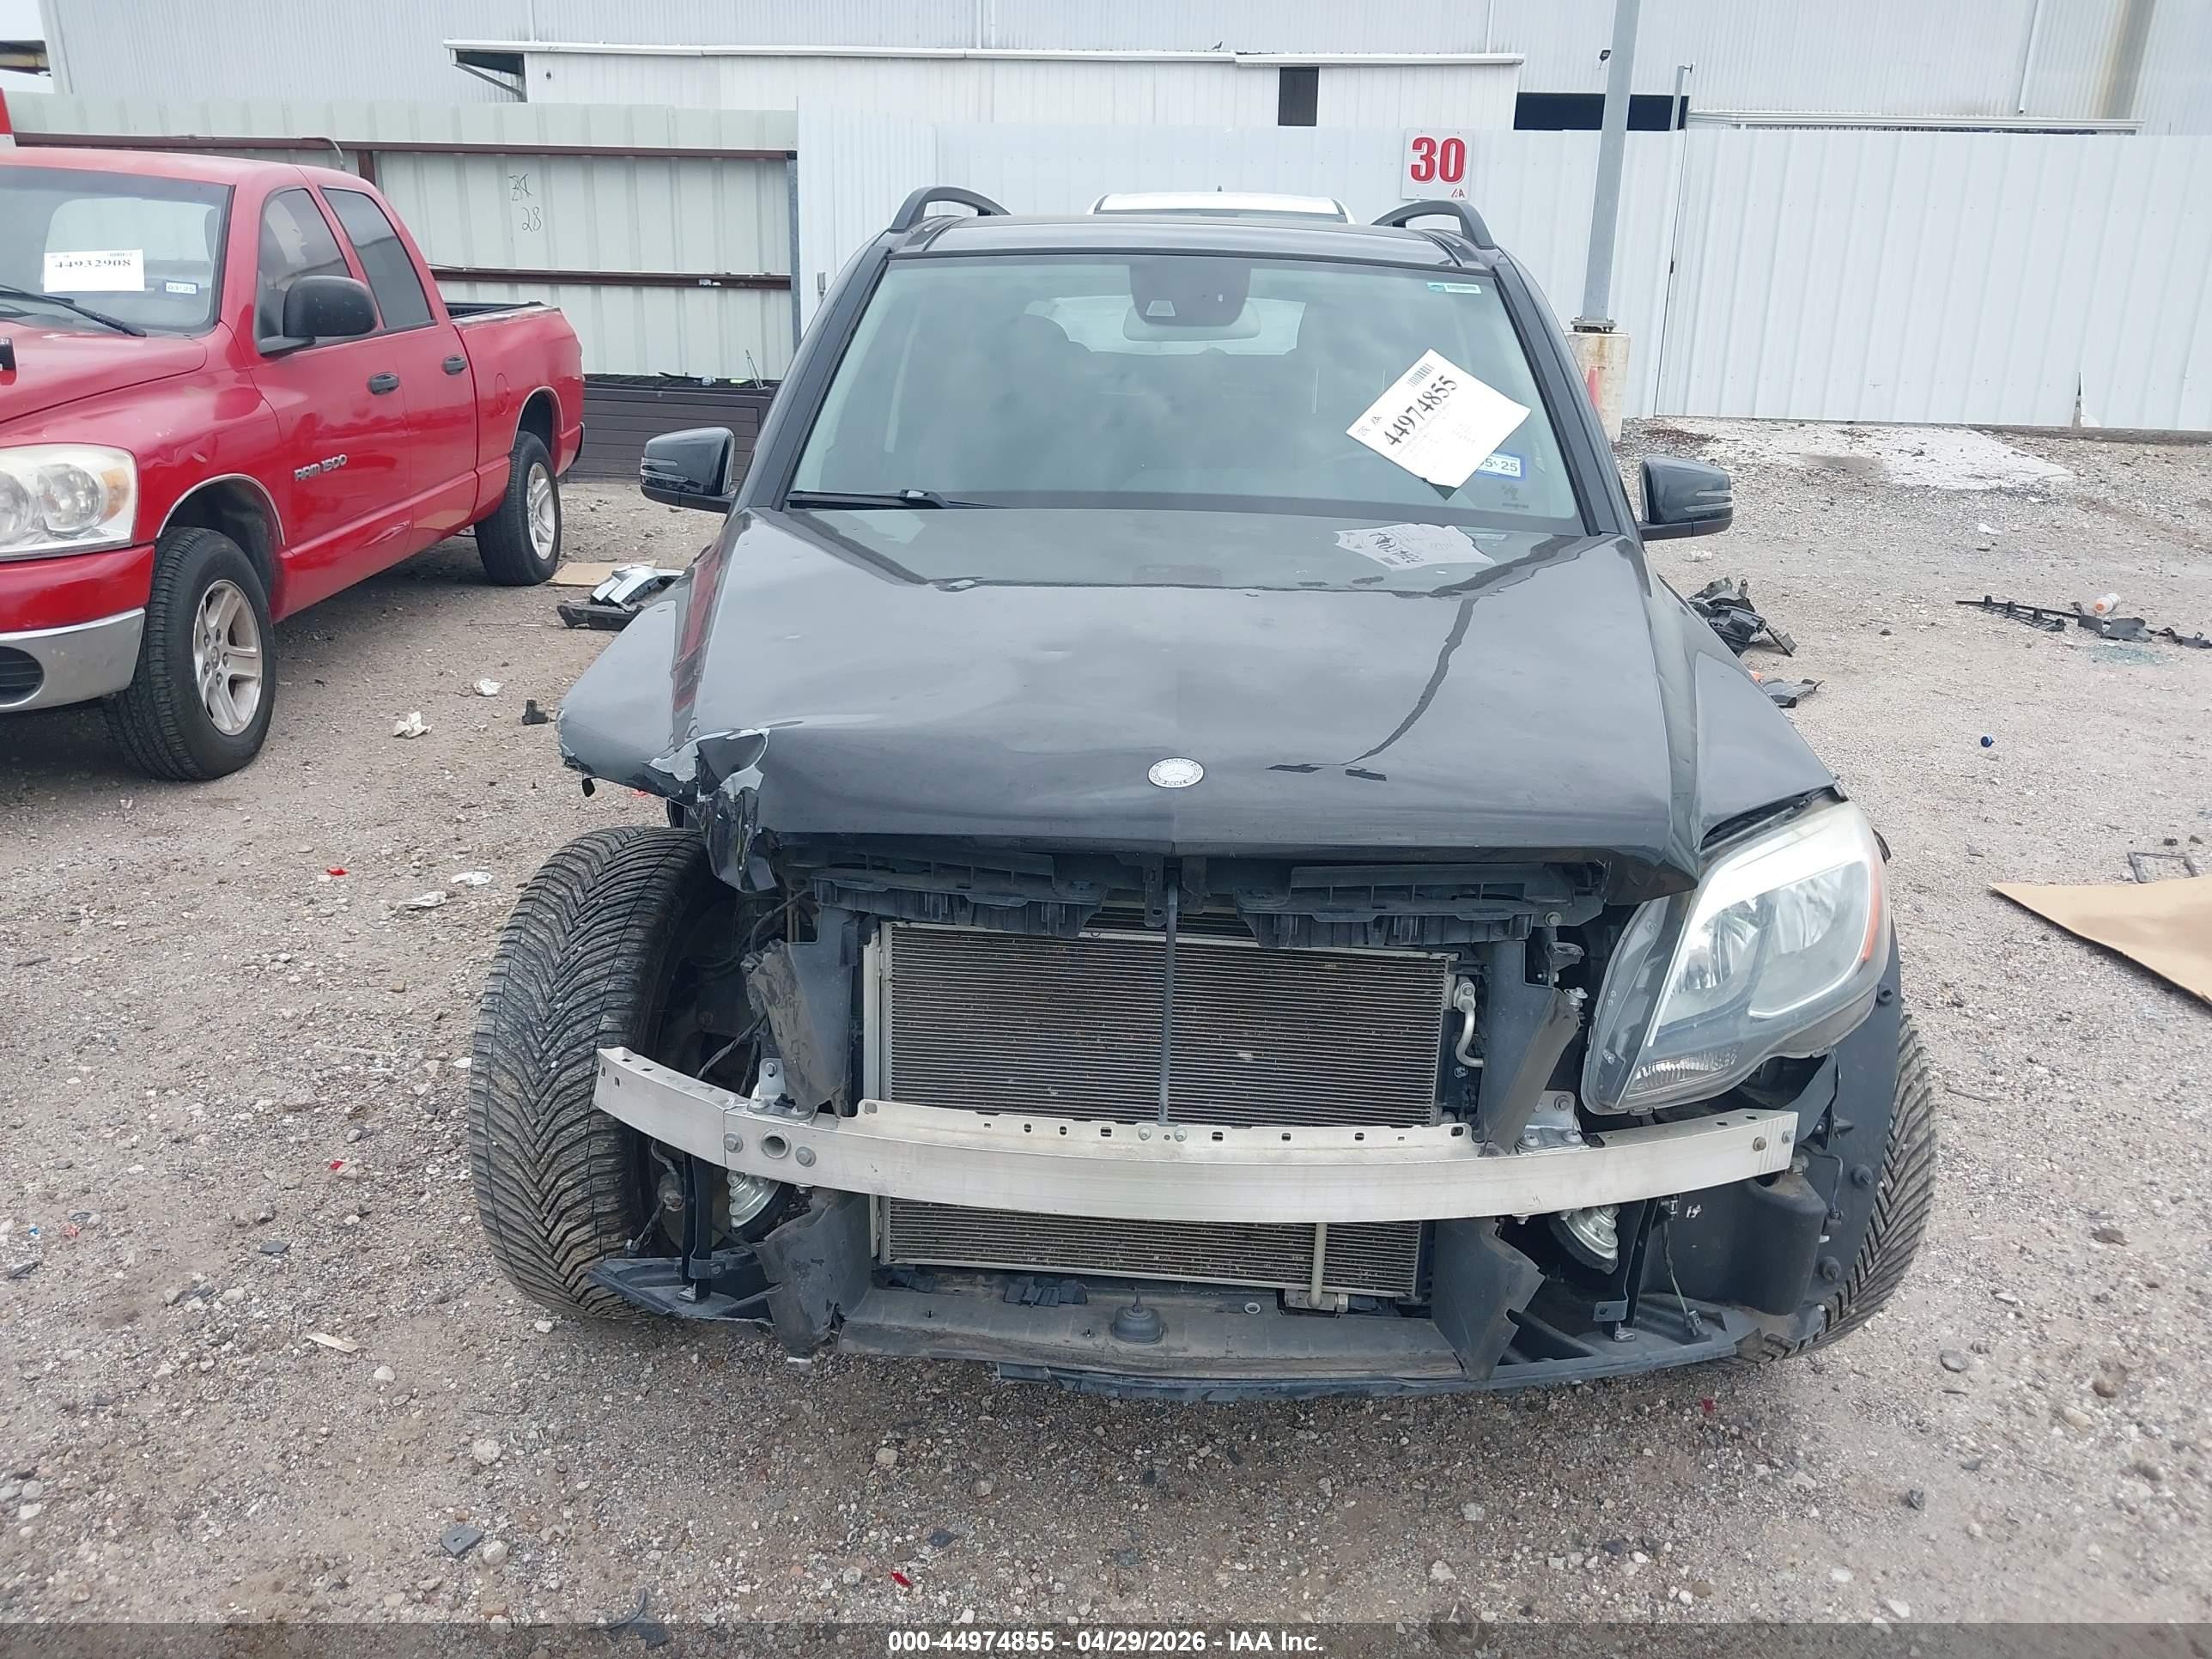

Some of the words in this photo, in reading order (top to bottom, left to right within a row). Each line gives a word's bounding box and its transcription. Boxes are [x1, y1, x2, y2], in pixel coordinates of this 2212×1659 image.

[1410, 136, 1467, 184] 30
[521, 206, 543, 234] 28
[1383, 374, 1458, 446] 44974855
[294, 463, 320, 482] RAM
[321, 453, 348, 472] 1500
